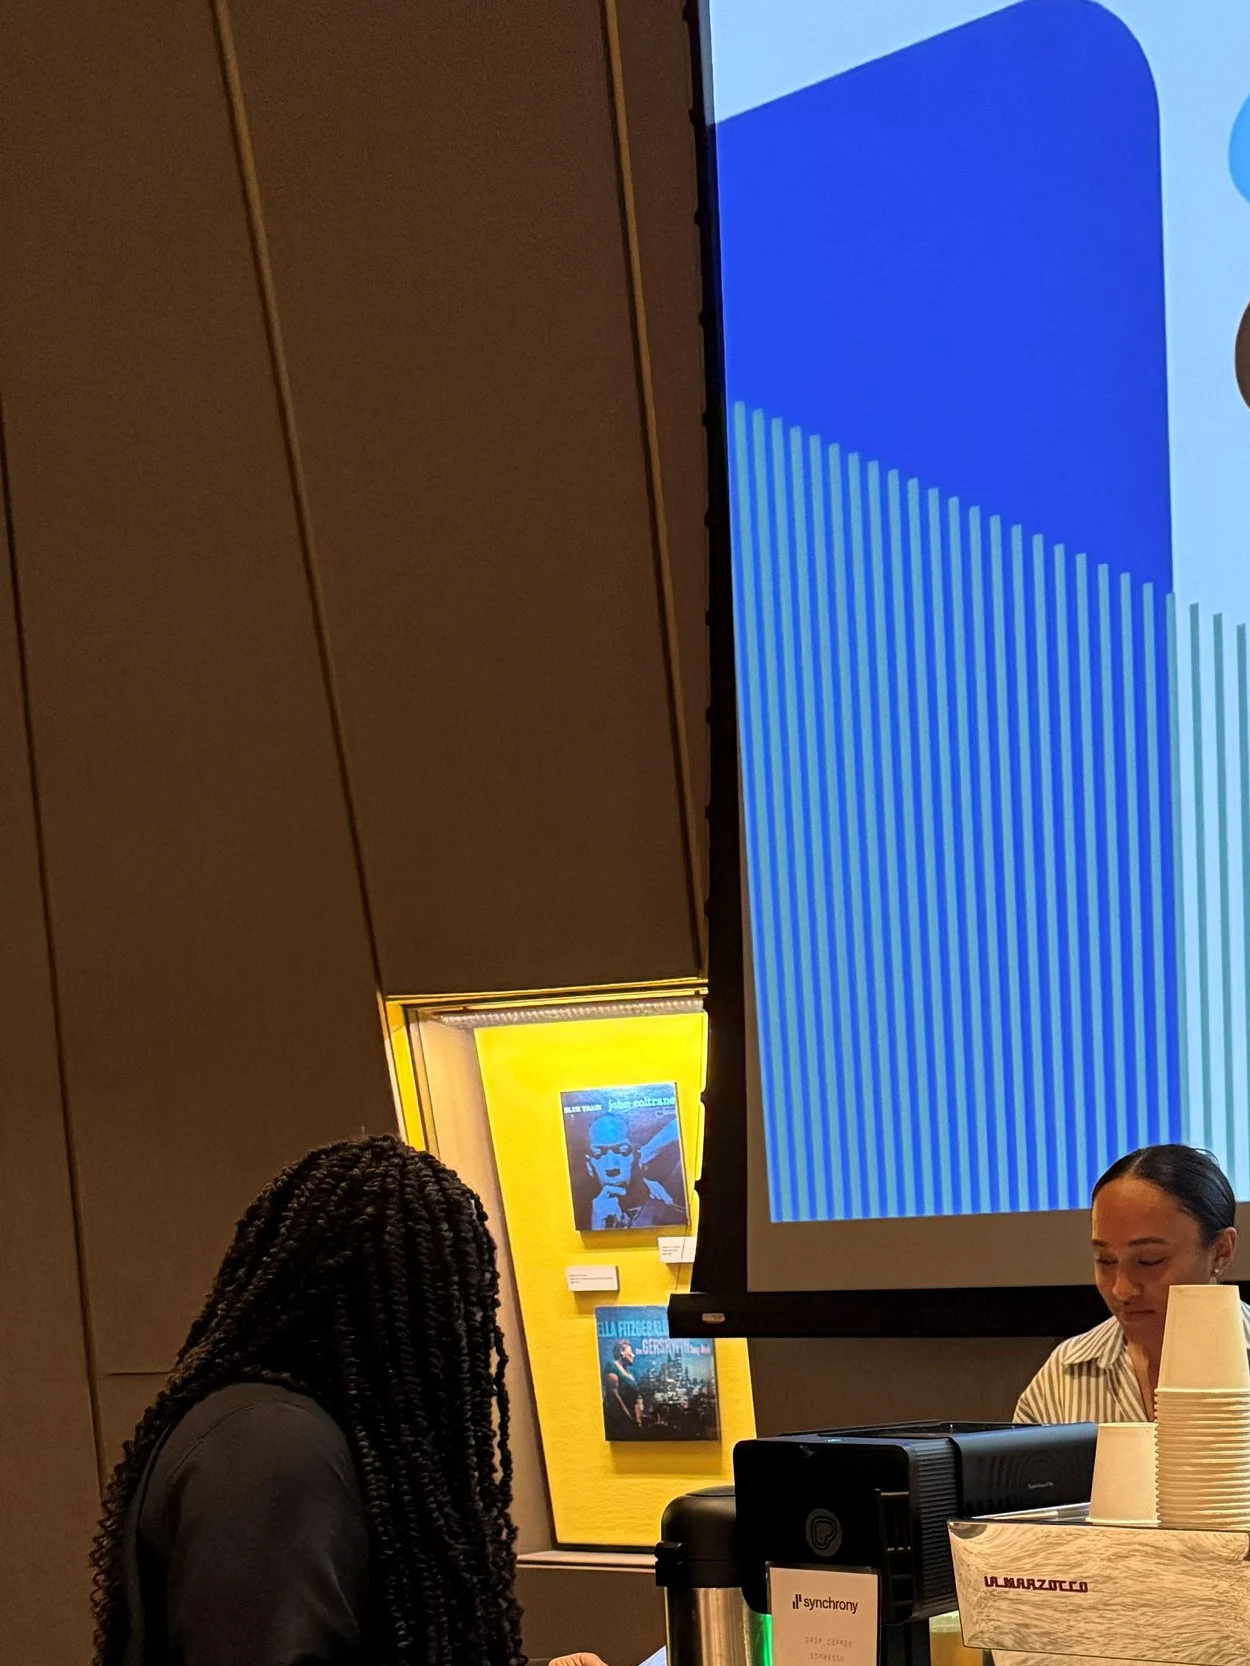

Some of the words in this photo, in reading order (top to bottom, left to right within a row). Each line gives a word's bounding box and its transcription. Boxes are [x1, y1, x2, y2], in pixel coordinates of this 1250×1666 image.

[598, 1320, 617, 1337] ELLA
[984, 1576, 1002, 1589] LA
[1003, 1577, 1088, 1593] MARZOCCO
[803, 1596, 859, 1615] synchrony
